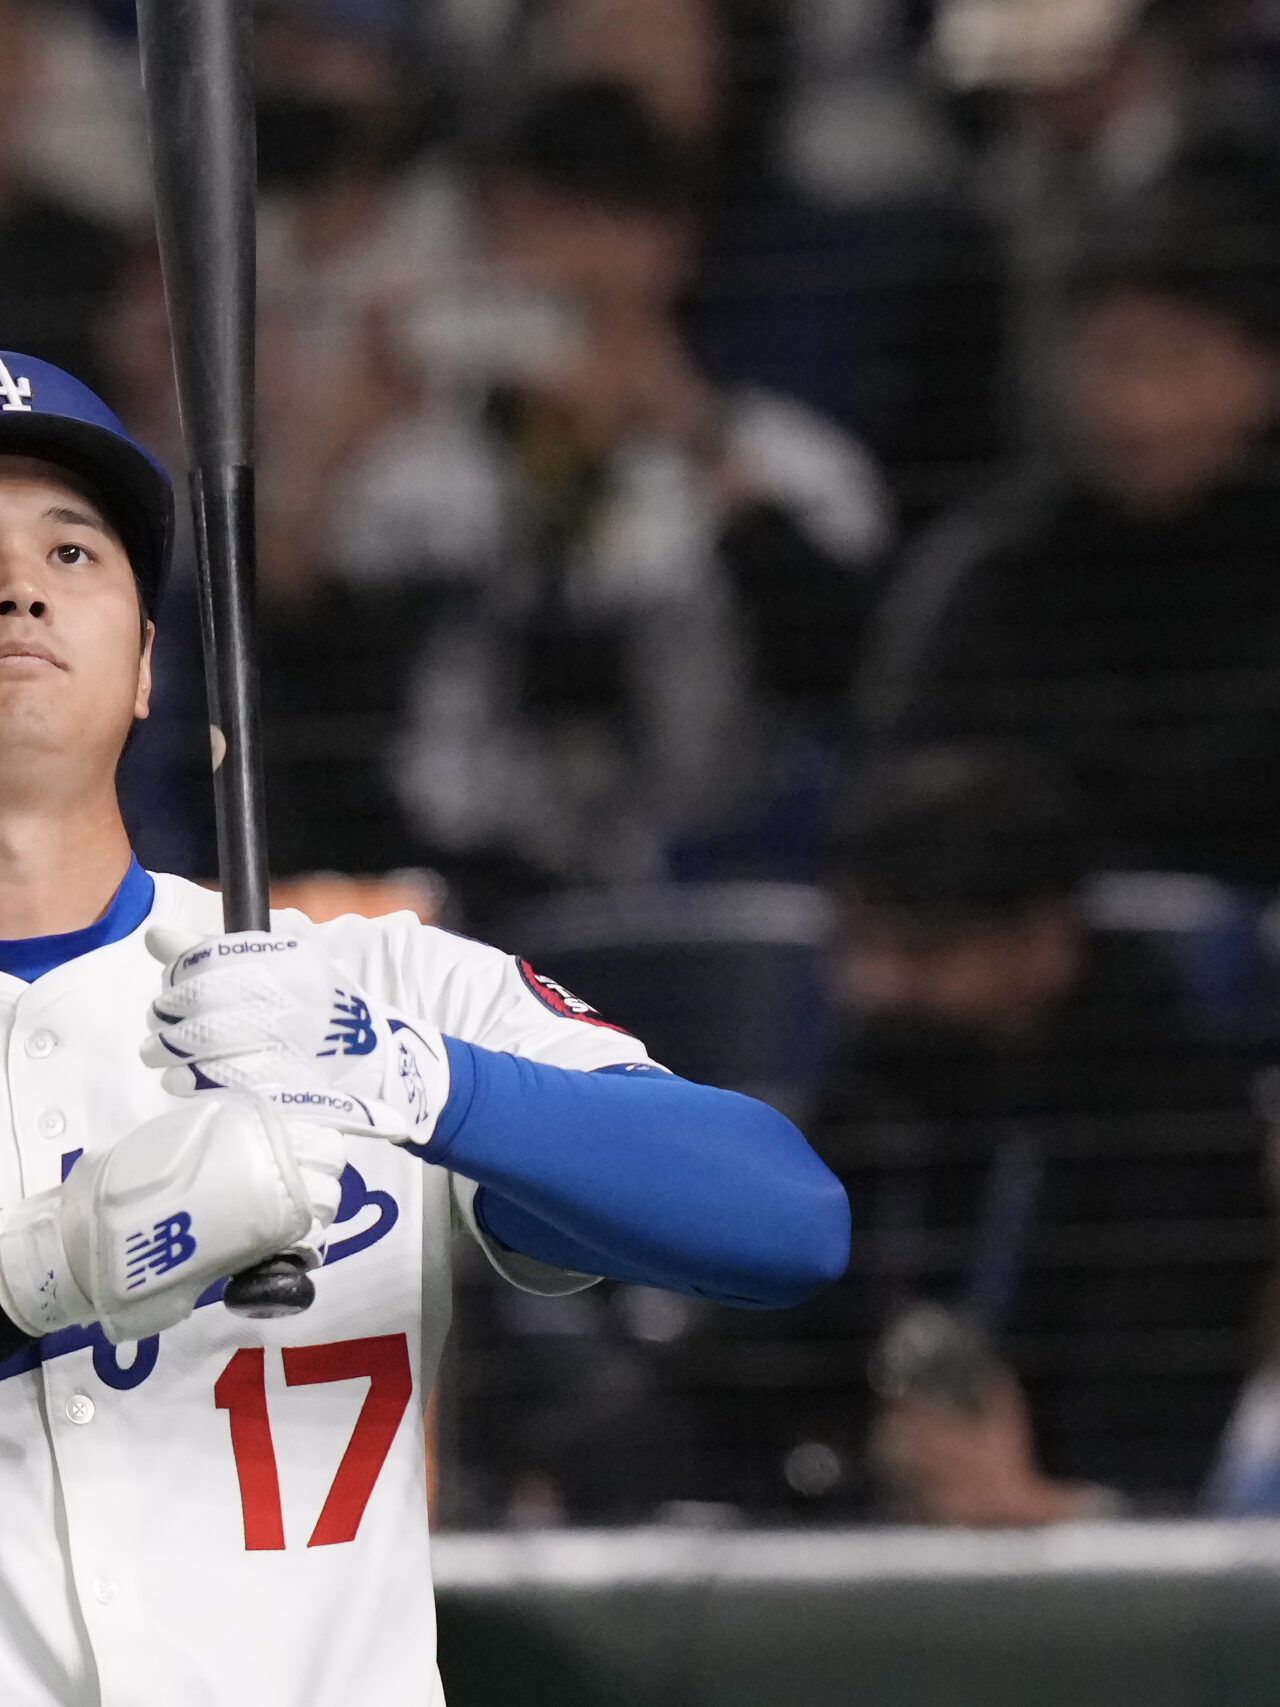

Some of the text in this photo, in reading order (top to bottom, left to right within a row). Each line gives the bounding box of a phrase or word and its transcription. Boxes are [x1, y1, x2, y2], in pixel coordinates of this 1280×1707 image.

[182, 940, 297, 970] new balance
[281, 1091, 353, 1112] balance
[213, 1332, 413, 1552] 17
